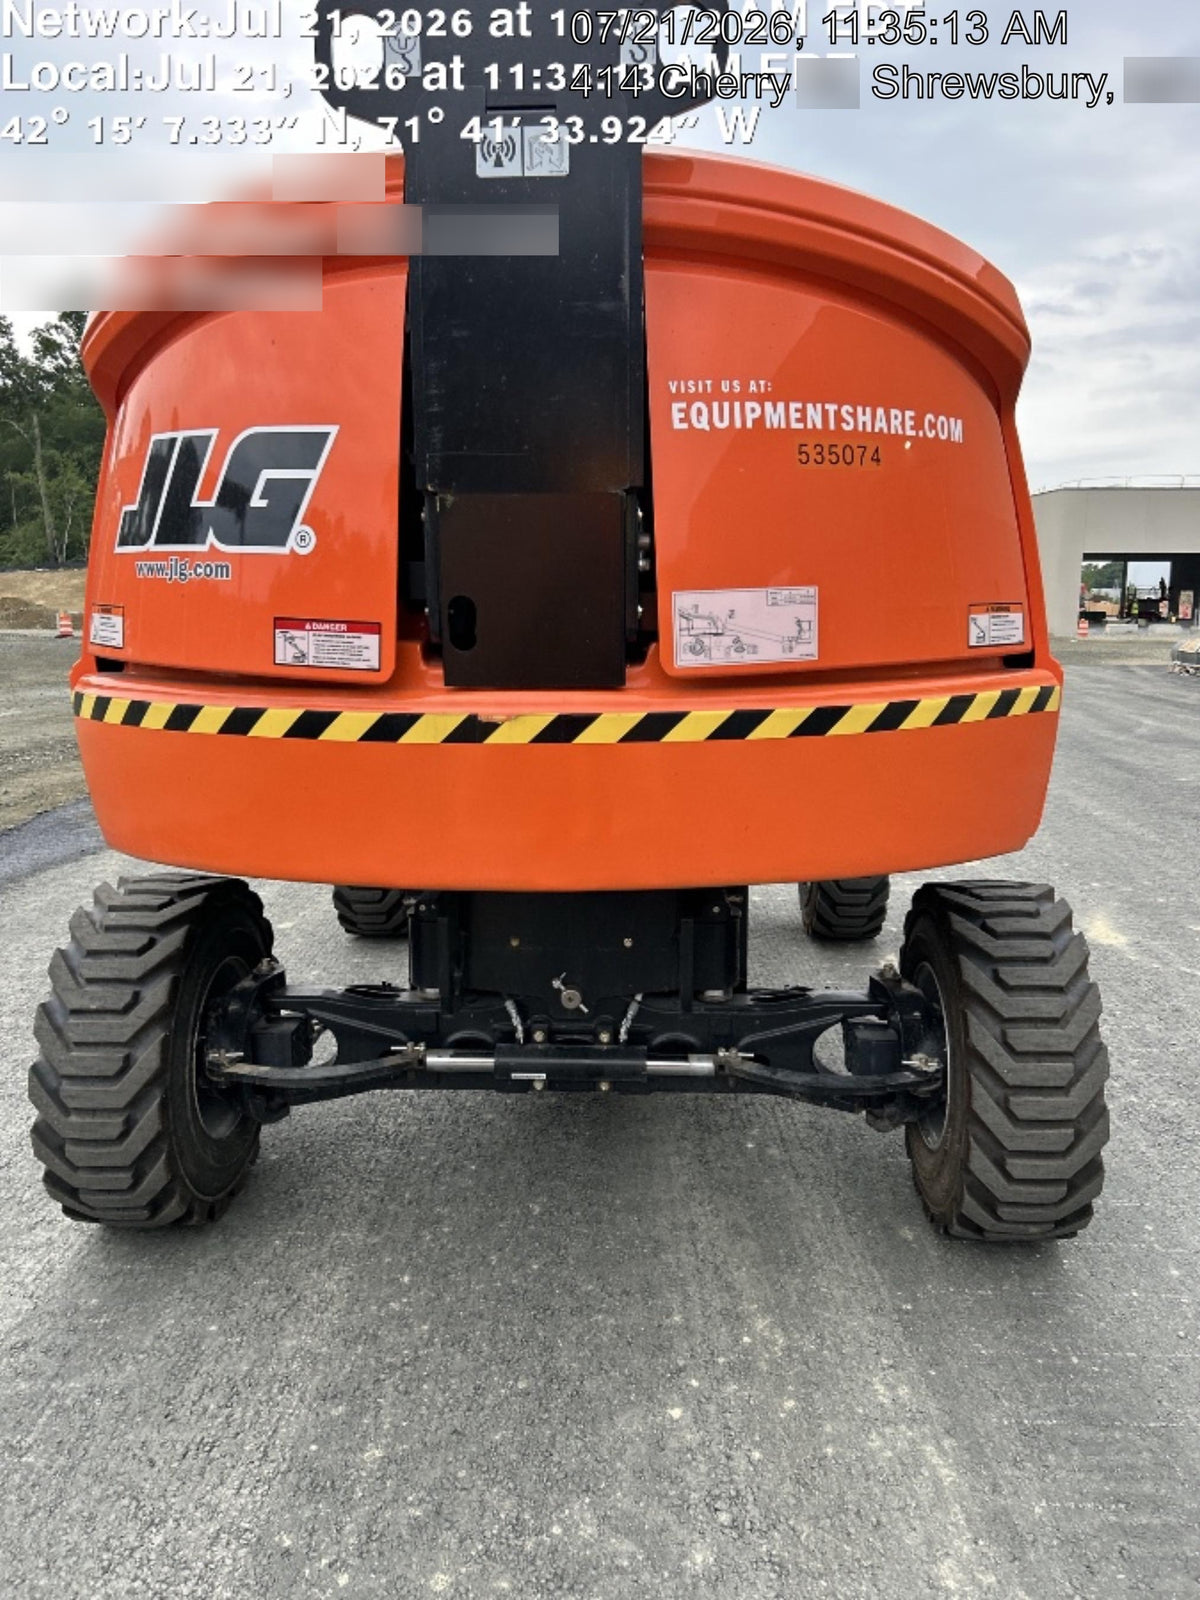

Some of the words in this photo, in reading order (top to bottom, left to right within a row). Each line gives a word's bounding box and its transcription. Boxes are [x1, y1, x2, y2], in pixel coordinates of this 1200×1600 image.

[668, 380, 713, 394] VISIT
[720, 380, 741, 392] US
[749, 380, 773, 393] AT:
[671, 401, 964, 443] EQUIPMENTSHARE.COM
[797, 443, 881, 467] 535074
[114, 425, 340, 554] JLG
[136, 558, 232, 583] www.jlg.com
